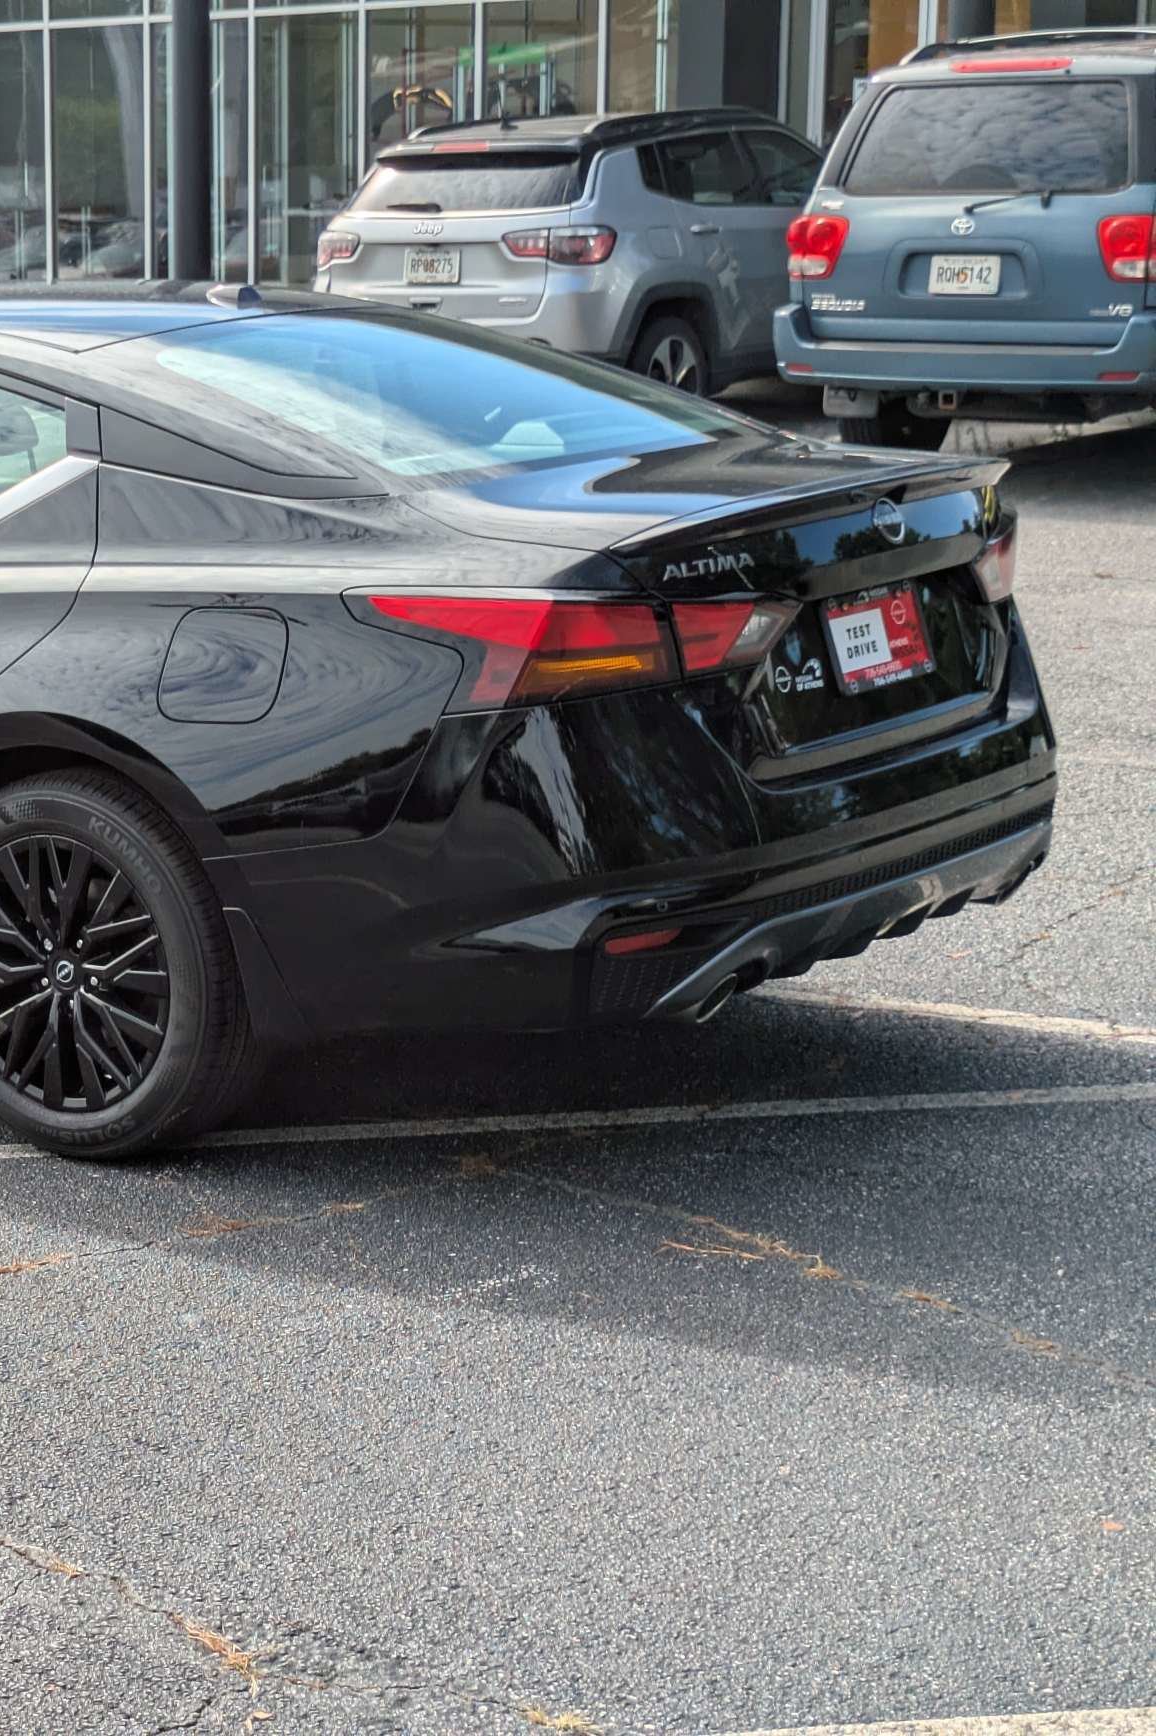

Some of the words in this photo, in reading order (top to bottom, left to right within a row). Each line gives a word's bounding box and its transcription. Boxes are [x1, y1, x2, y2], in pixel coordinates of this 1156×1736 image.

[413, 222, 444, 237] Jeep
[663, 552, 755, 581] ALTIMA
[846, 623, 872, 641] TEST
[847, 640, 878, 660] DRIVE
[87, 816, 162, 895] KUMHO
